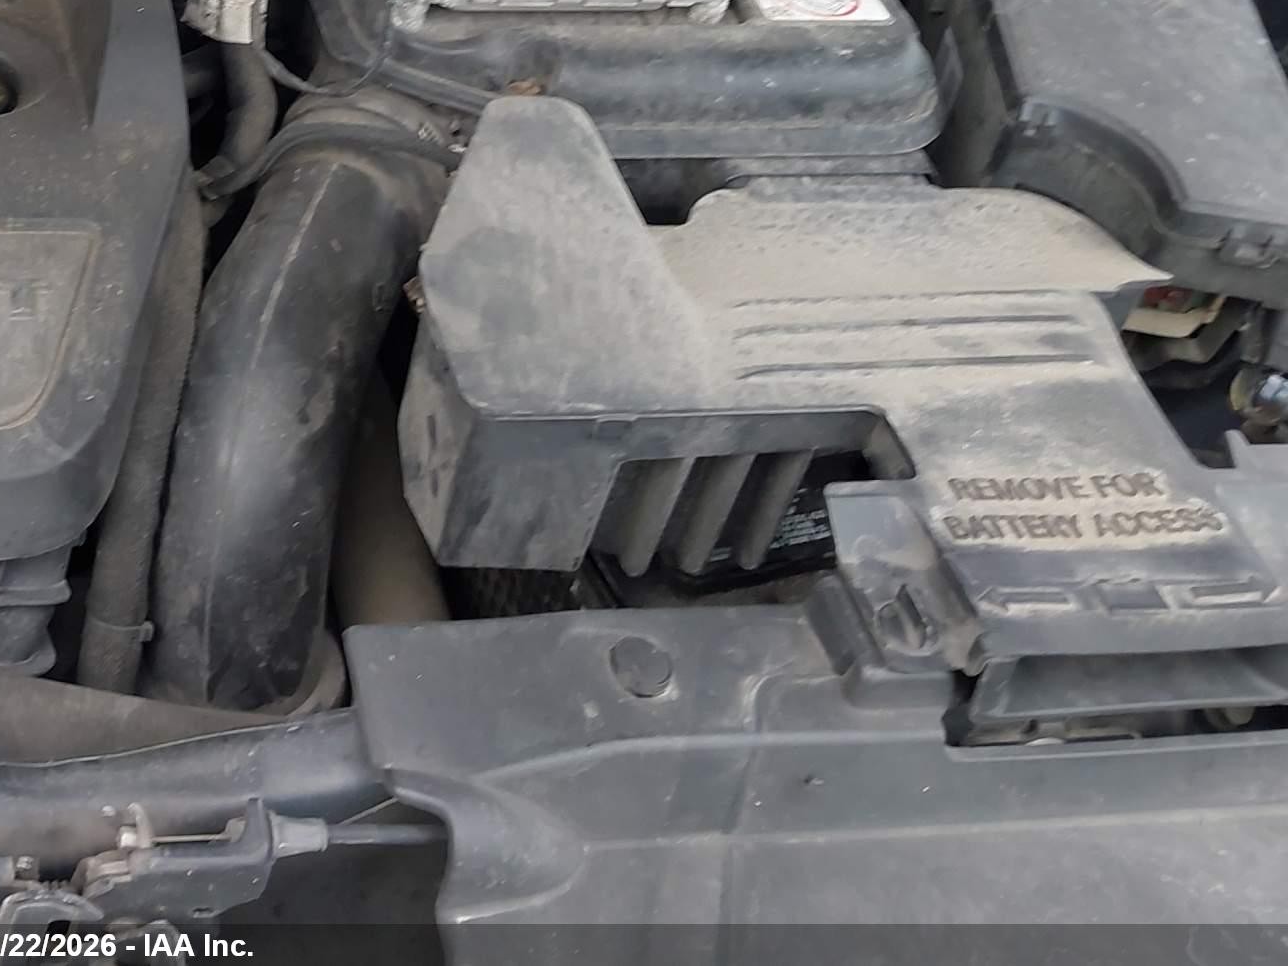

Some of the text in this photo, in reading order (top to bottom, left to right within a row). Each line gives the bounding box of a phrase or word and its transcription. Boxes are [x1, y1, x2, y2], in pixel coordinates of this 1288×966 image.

[947, 472, 1165, 501] REMOVE FOR
[942, 507, 1223, 540] BATTERY ACCESS
